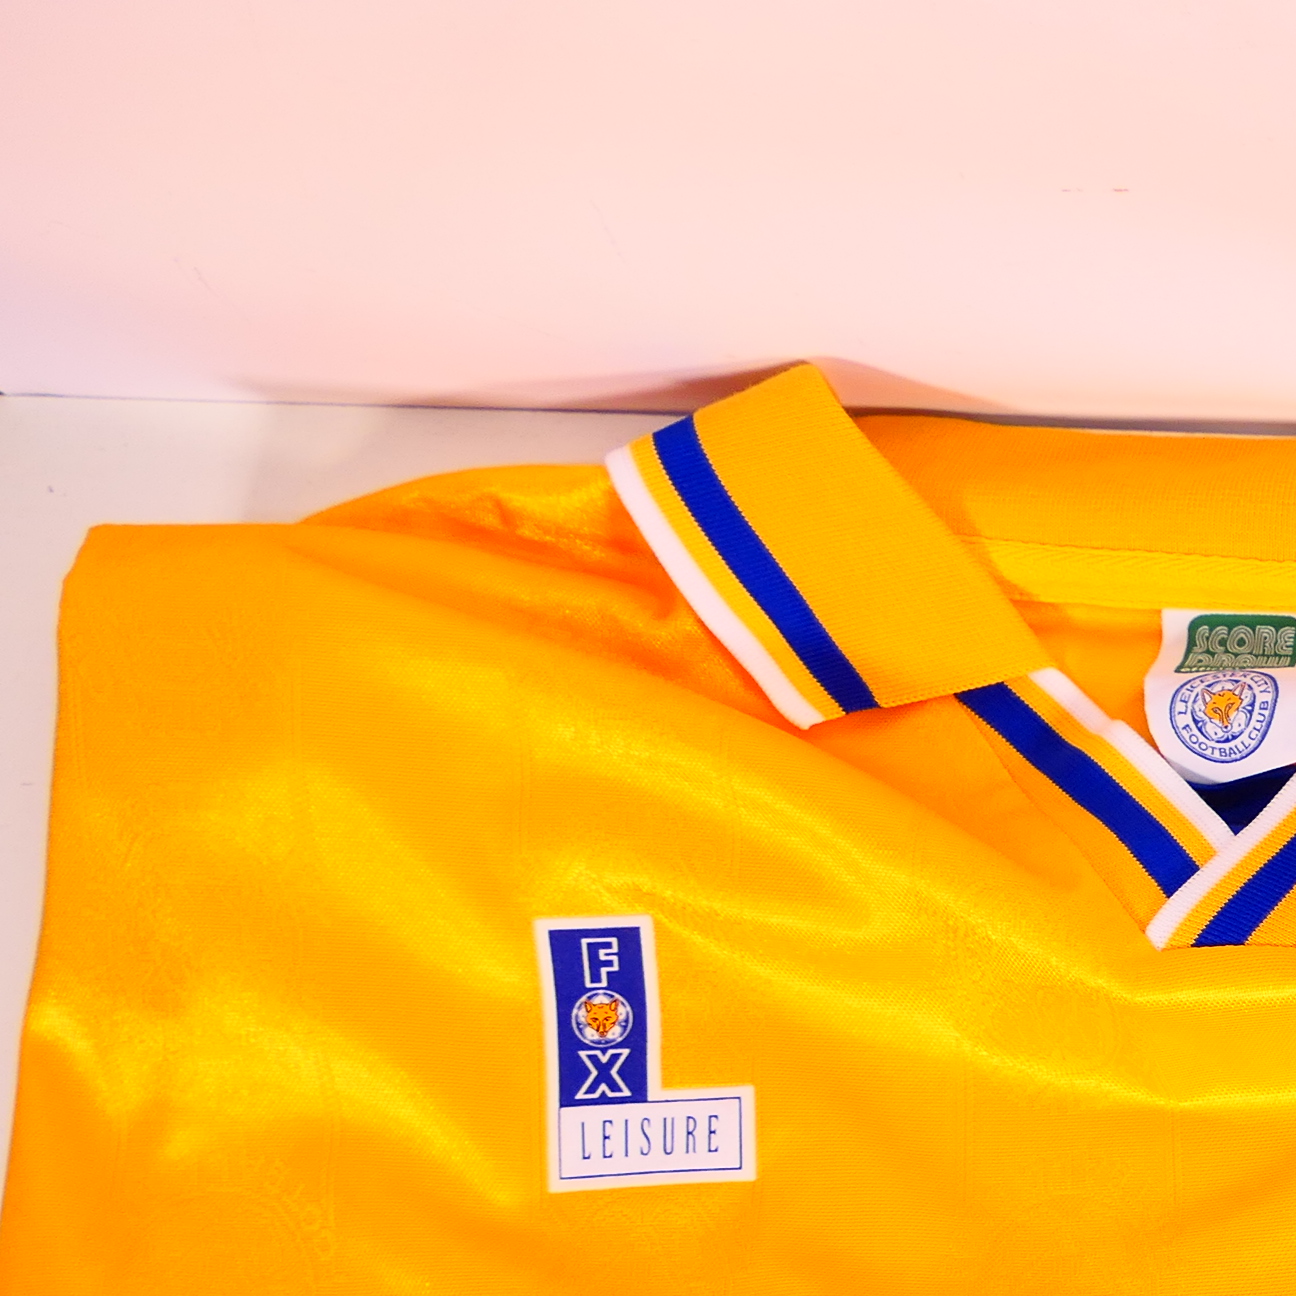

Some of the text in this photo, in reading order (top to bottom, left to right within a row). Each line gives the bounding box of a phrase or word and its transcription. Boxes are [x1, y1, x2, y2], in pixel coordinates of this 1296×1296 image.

[1192, 625, 1296, 655] SCORE
[1250, 675, 1272, 694] CITY
[1181, 700, 1269, 758] FOOTBALL CLUB
[581, 1114, 719, 1160] LEISURE
